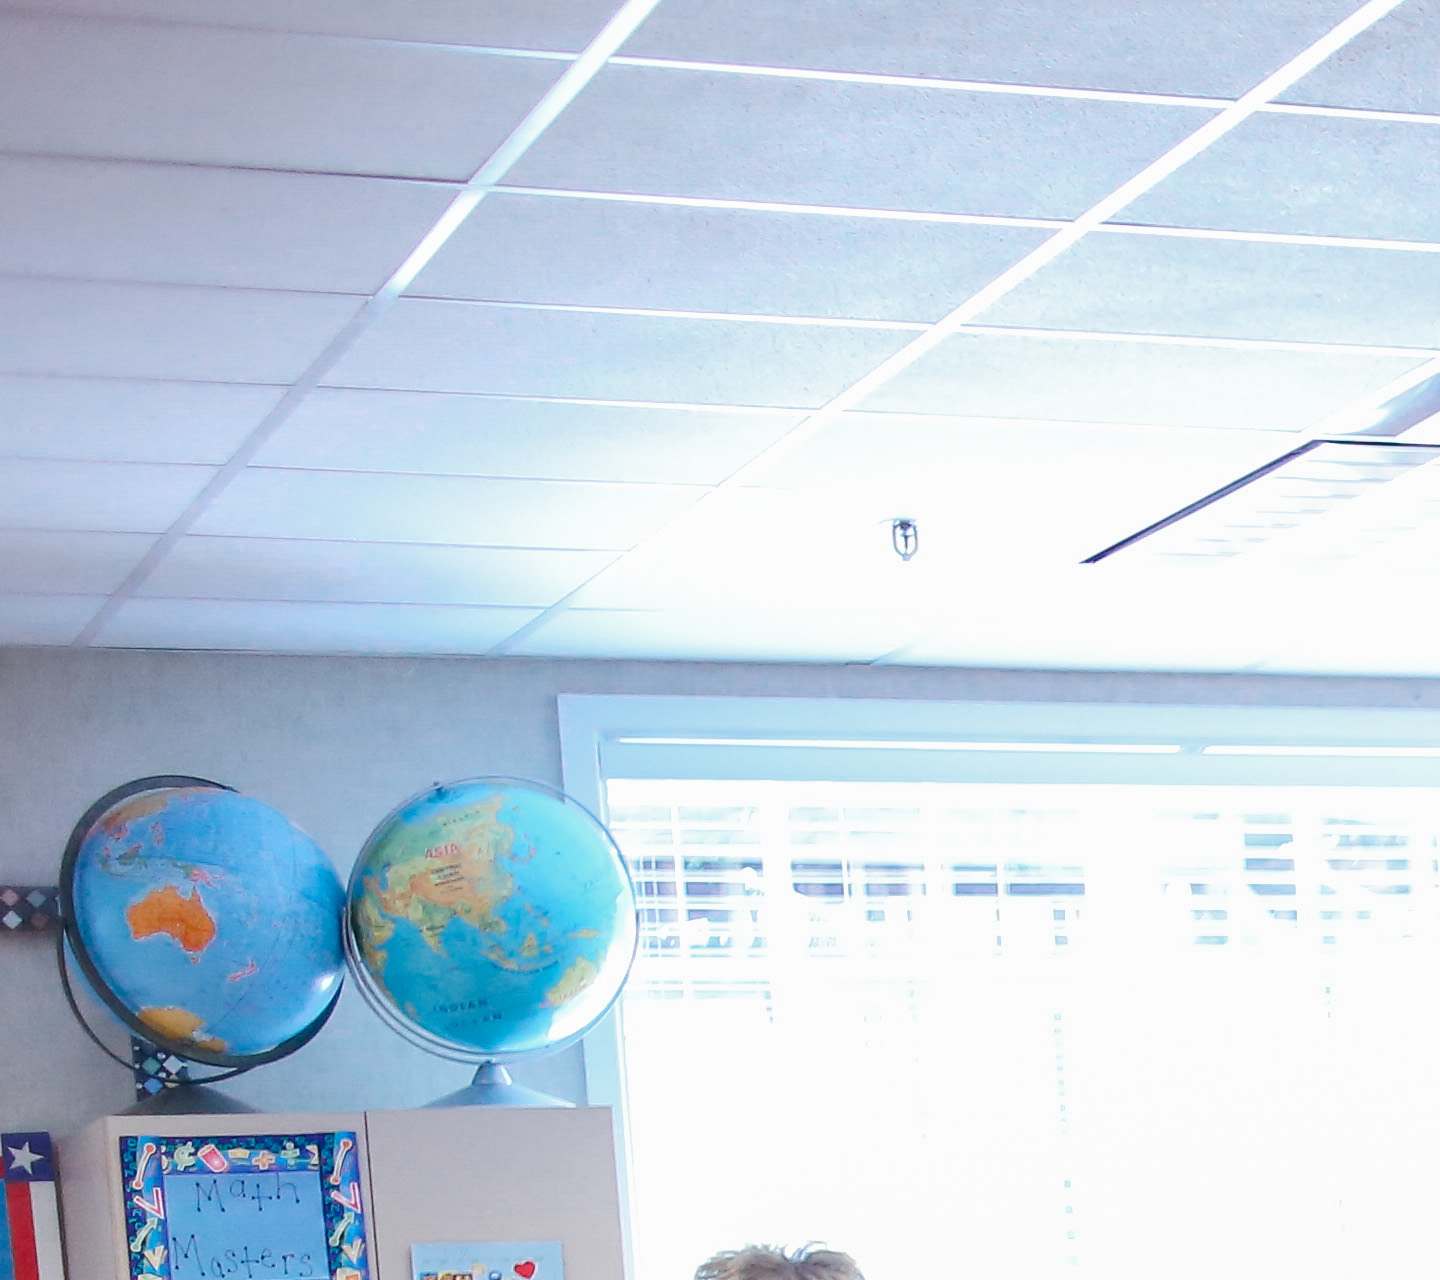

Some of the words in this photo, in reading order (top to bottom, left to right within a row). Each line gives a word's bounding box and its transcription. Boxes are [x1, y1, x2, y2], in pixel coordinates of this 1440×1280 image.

[424, 843, 462, 860] ASIA
[195, 1171, 301, 1213] Math
[171, 1234, 313, 1279] Masters
